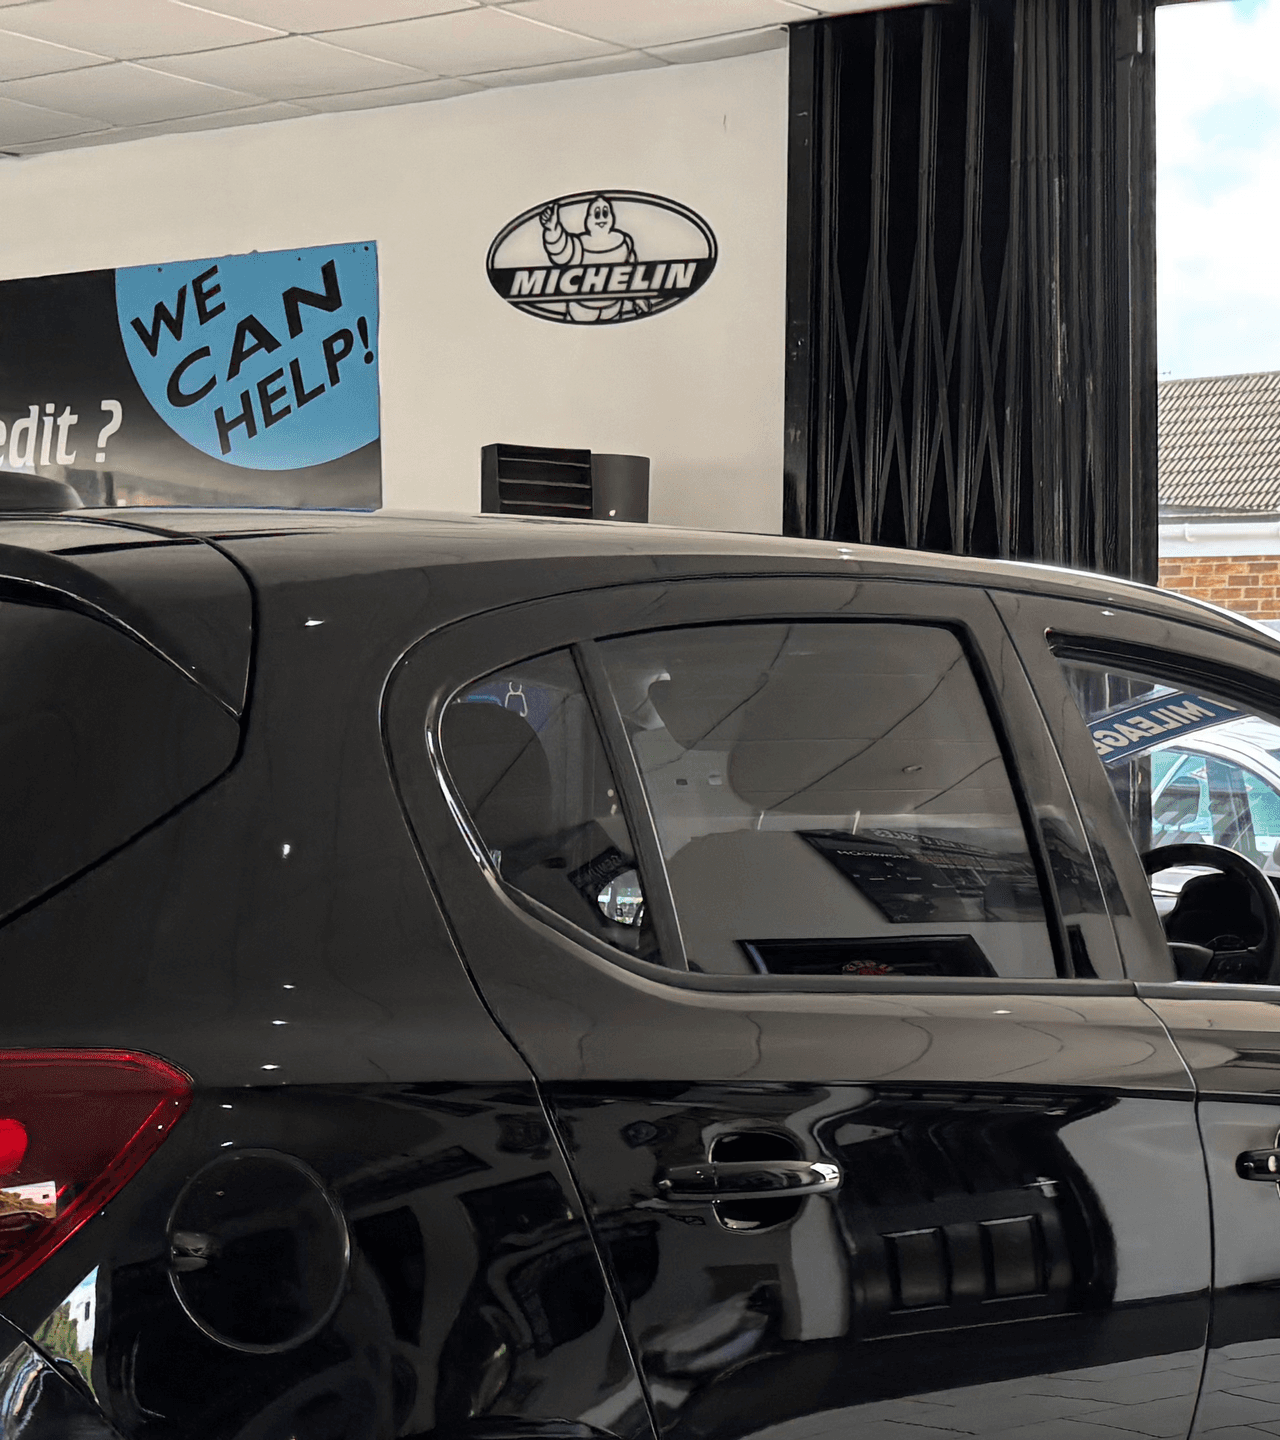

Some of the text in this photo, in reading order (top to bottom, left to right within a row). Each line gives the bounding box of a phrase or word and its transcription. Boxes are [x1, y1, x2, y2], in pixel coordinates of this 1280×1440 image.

[130, 265, 226, 358] WE
[509, 262, 697, 296] MICHELIN
[167, 259, 343, 408] CAN
[95, 400, 123, 463] ?
[214, 316, 374, 456] HELP!
